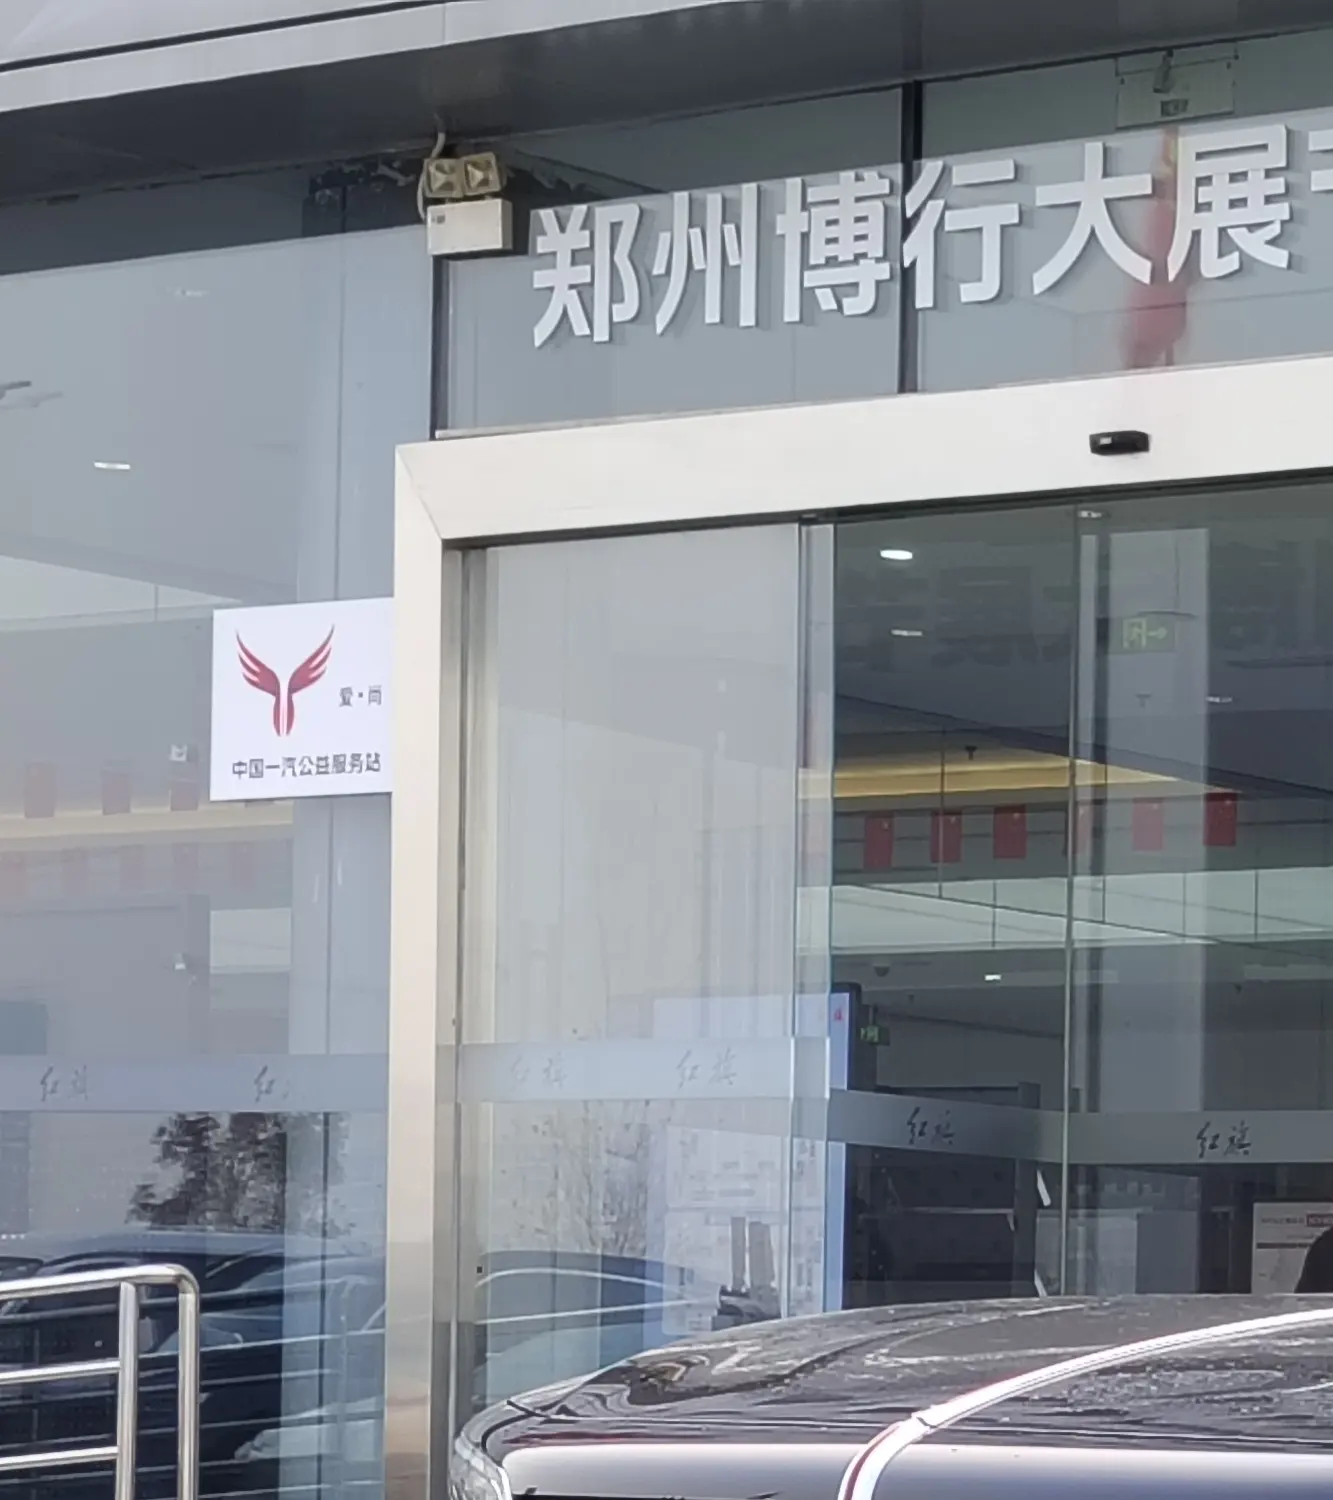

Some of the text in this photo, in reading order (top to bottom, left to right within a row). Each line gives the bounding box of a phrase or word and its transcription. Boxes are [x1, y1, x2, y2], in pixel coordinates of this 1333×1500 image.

[231, 751, 382, 781] 中国一汽公益服务站
